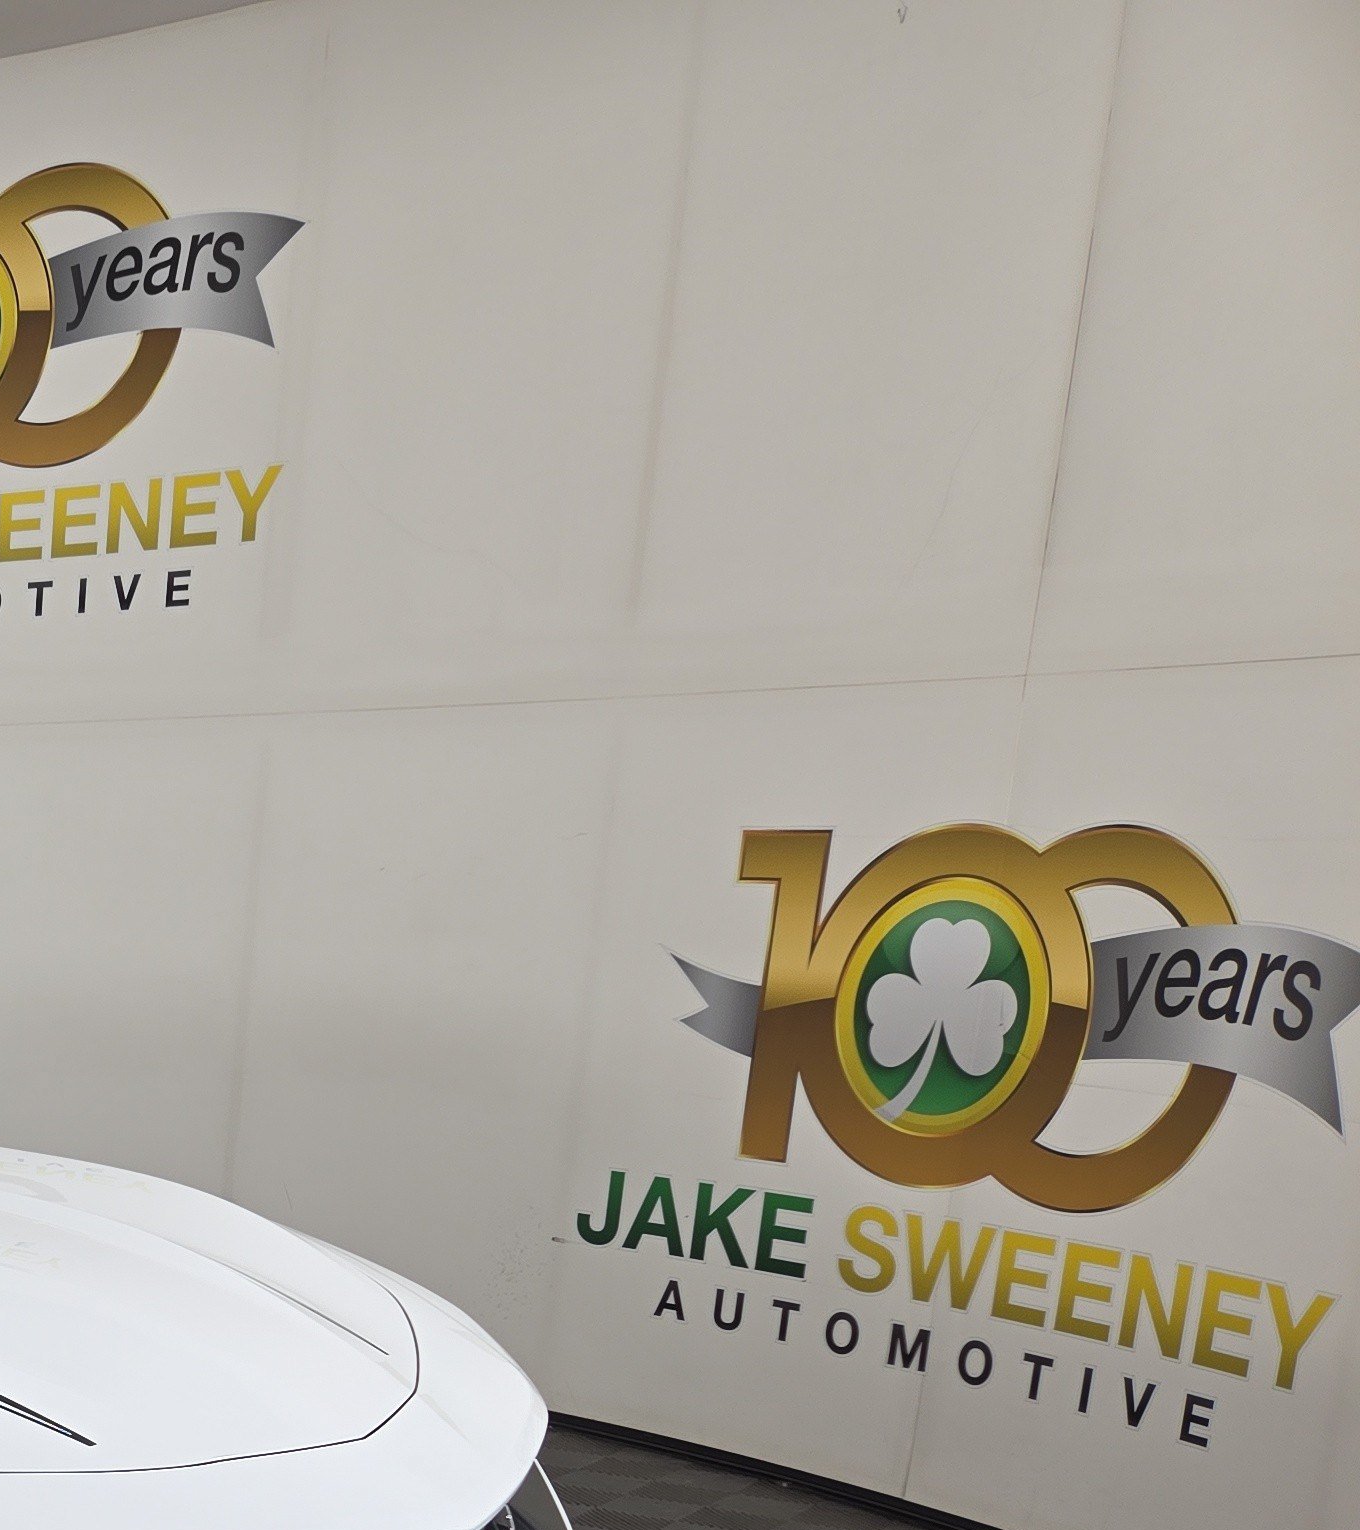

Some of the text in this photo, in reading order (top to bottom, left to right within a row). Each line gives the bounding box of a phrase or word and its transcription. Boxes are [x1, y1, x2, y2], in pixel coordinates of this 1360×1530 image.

[65, 230, 246, 332] years
[1100, 943, 1323, 1043] years
[575, 1169, 1340, 1391] JAKE SWEENEY
[652, 1279, 1216, 1449] AUTOMOTIVE
